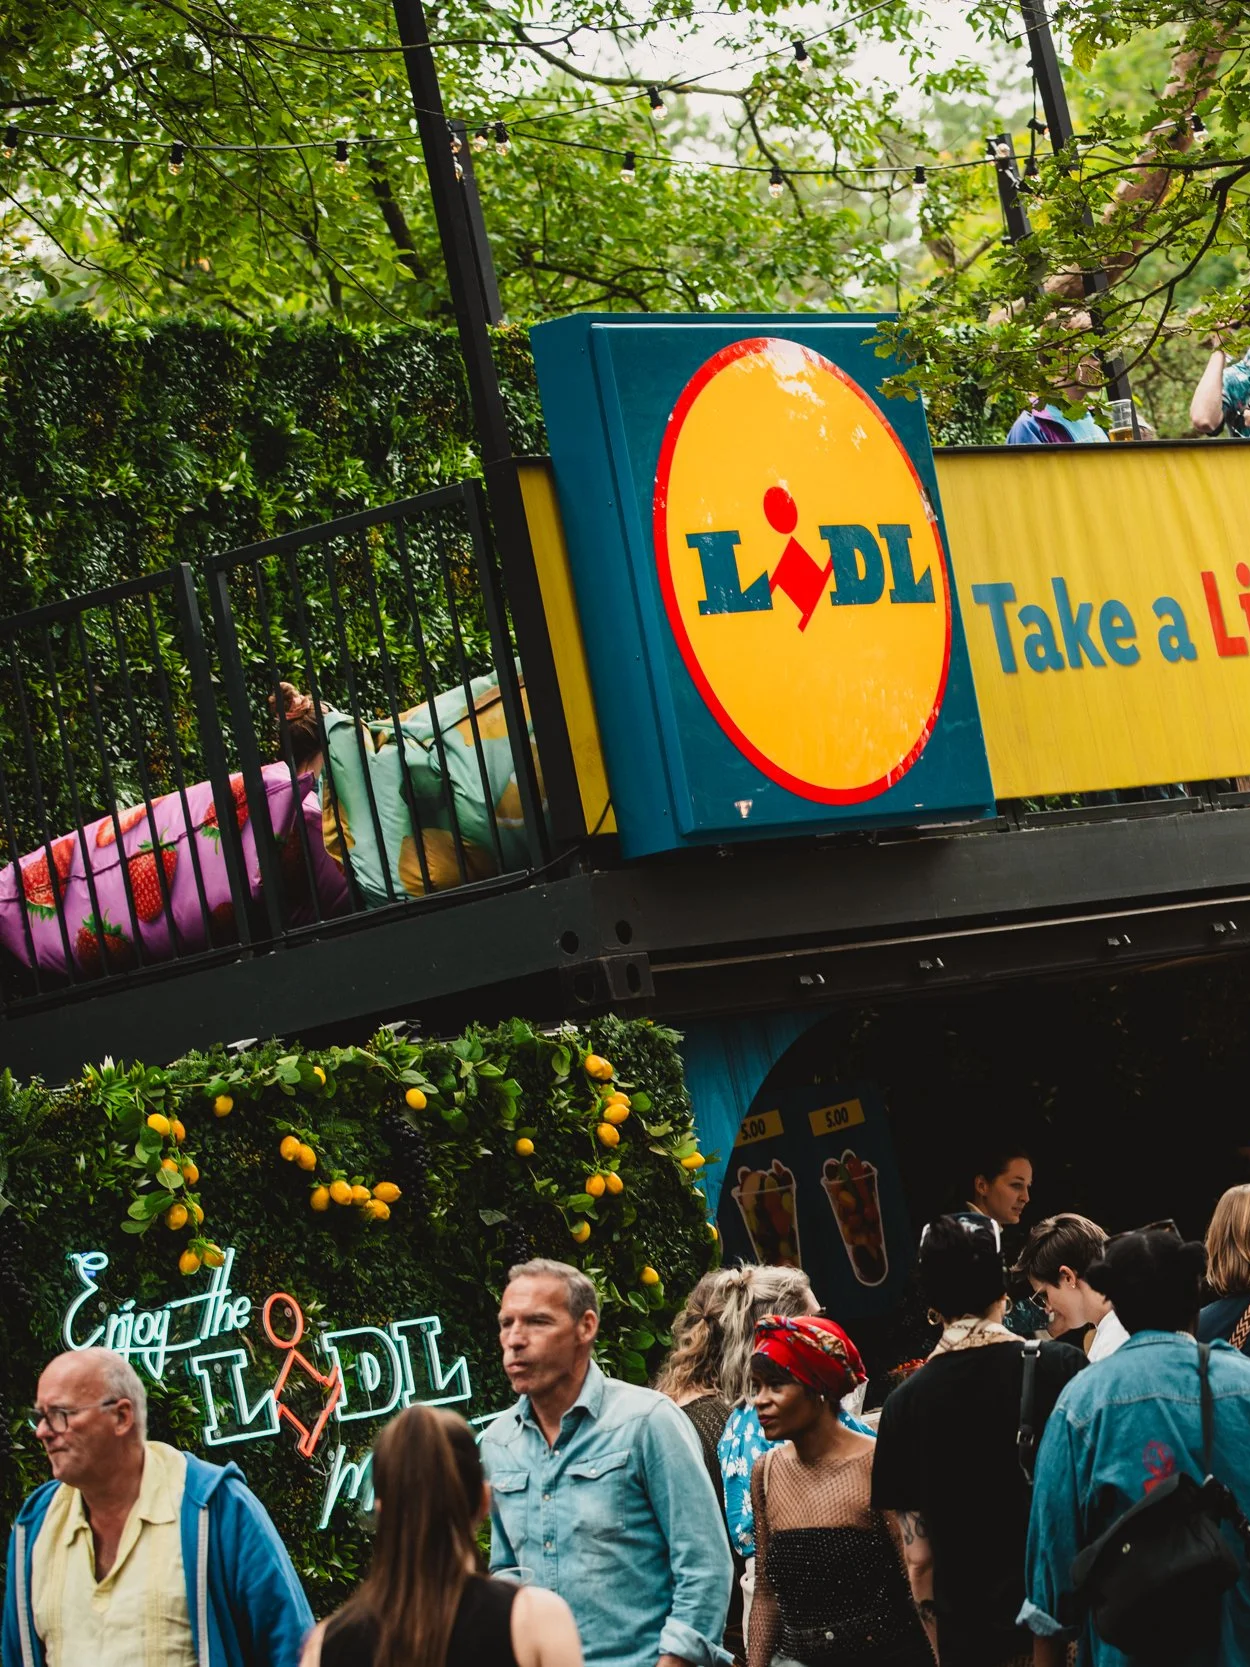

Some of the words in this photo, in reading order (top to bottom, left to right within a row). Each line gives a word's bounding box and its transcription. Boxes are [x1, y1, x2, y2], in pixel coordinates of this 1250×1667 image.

[971, 576, 1141, 674] Take
[1151, 596, 1198, 663] a
[740, 1118, 766, 1140] 5.00
[824, 1106, 849, 1128] 5.00
[63, 1251, 202, 1380] Enjoy
